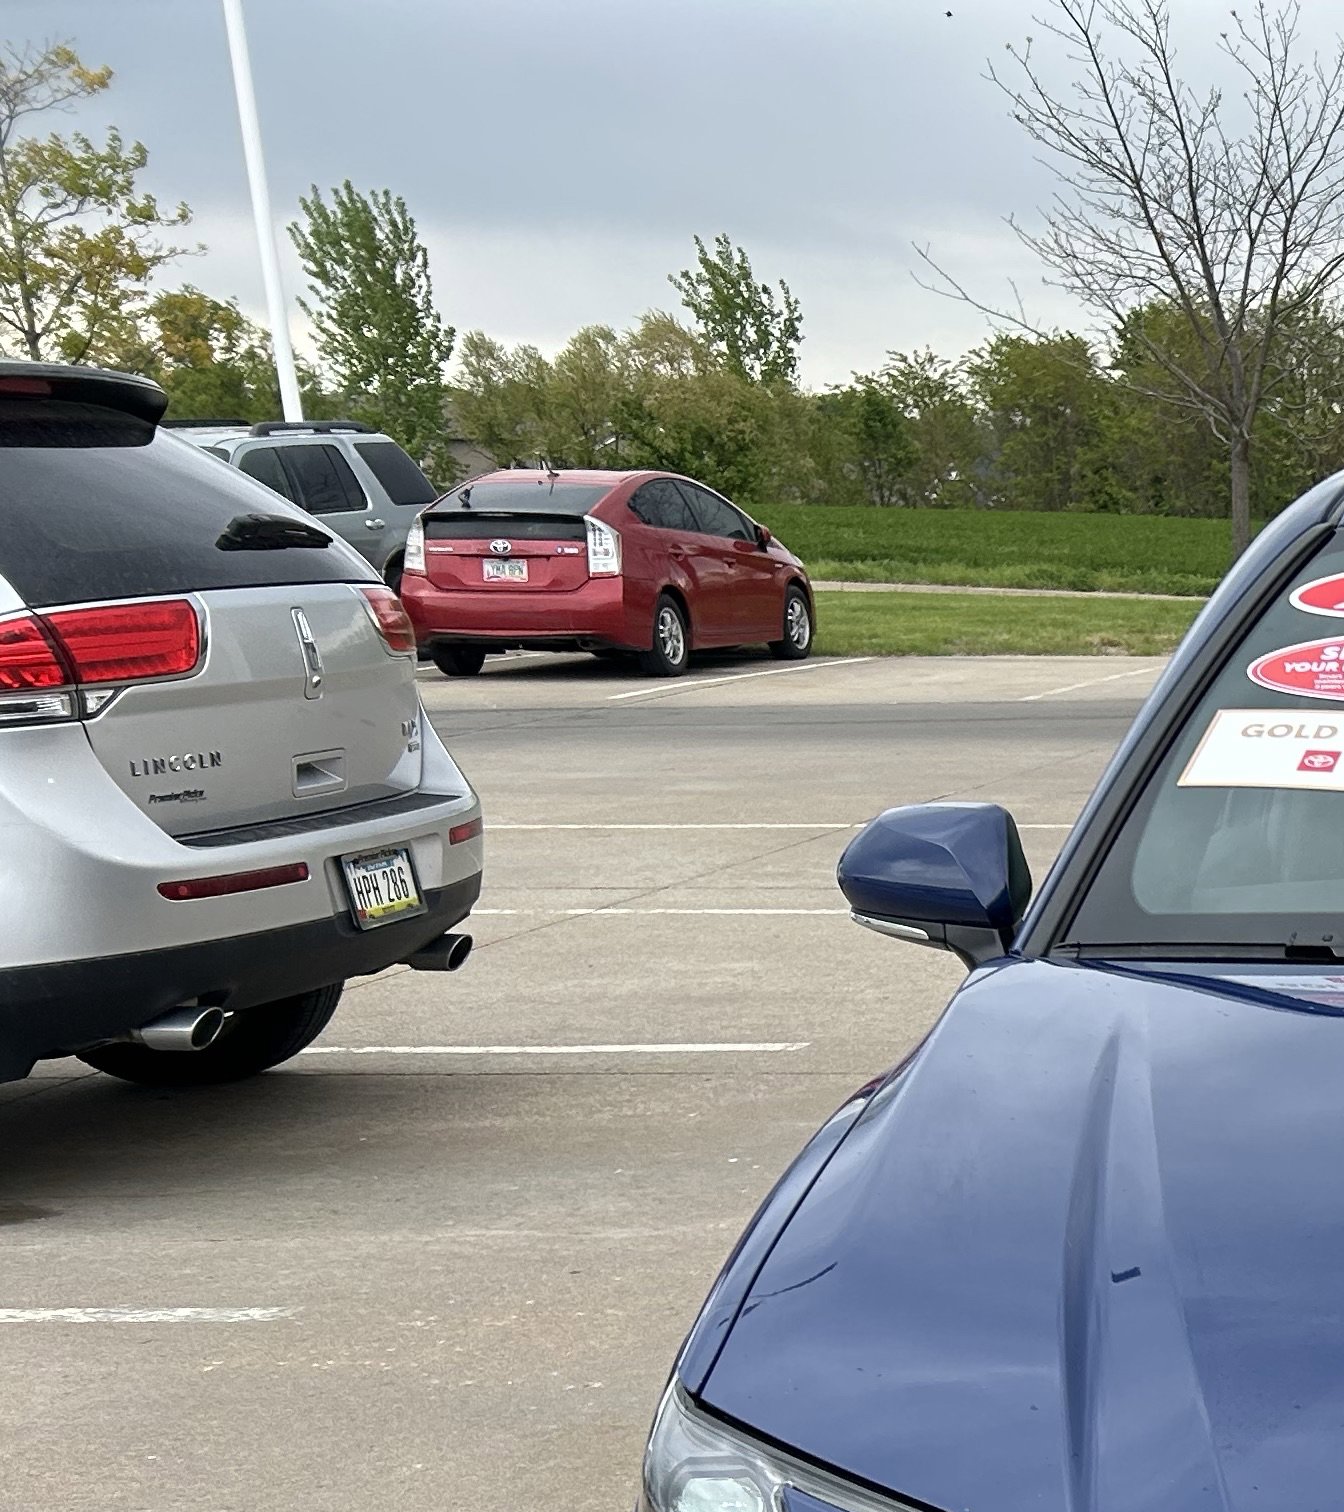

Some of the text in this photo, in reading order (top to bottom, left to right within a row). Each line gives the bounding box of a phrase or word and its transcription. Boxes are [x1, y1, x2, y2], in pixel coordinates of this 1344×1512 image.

[1283, 661, 1340, 673] YOUR
[1240, 723, 1338, 740] GOLD
[129, 750, 222, 777] LINCOLN
[353, 866, 410, 910] HPH 286
